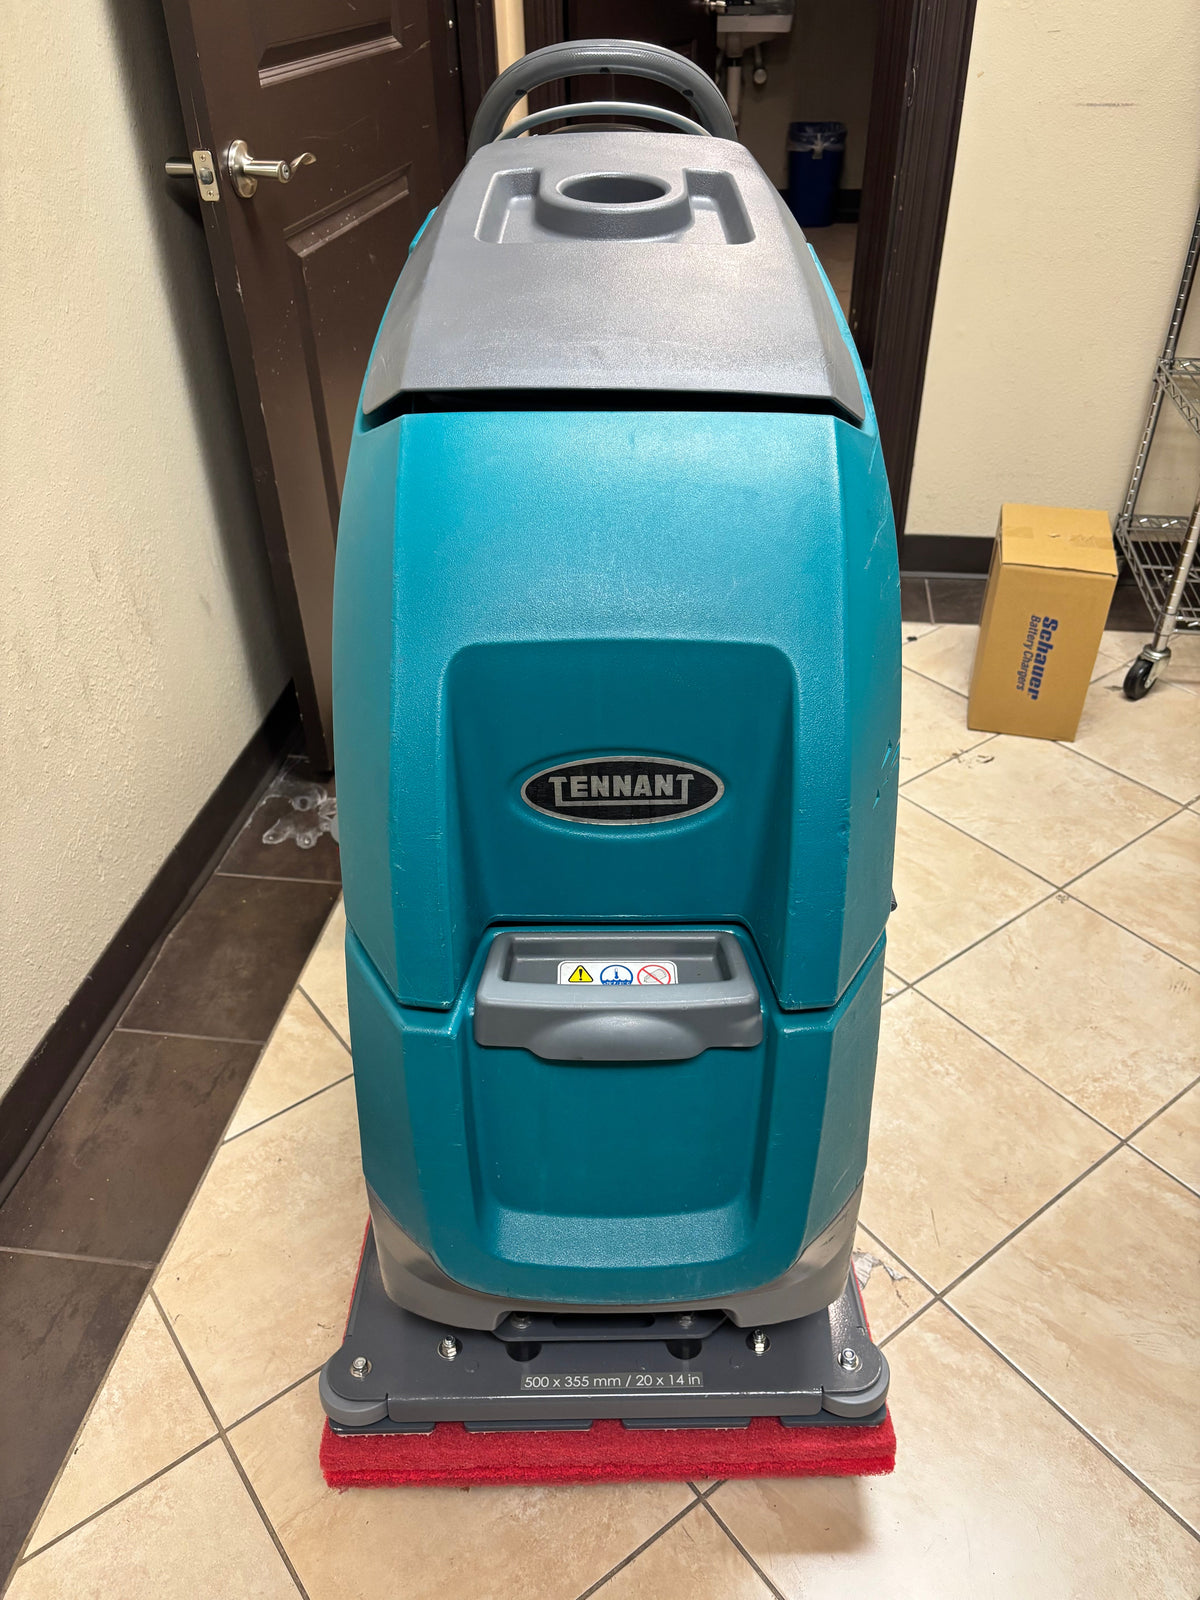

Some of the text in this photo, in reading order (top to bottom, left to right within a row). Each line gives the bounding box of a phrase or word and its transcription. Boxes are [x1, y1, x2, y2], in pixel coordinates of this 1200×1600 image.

[1016, 615, 1041, 691] Battery Chargers
[1028, 616, 1058, 700] Schauer
[548, 774, 695, 807] TENNANT
[524, 1374, 701, 1388] 500 x 355 mm / 20 x 14 in
